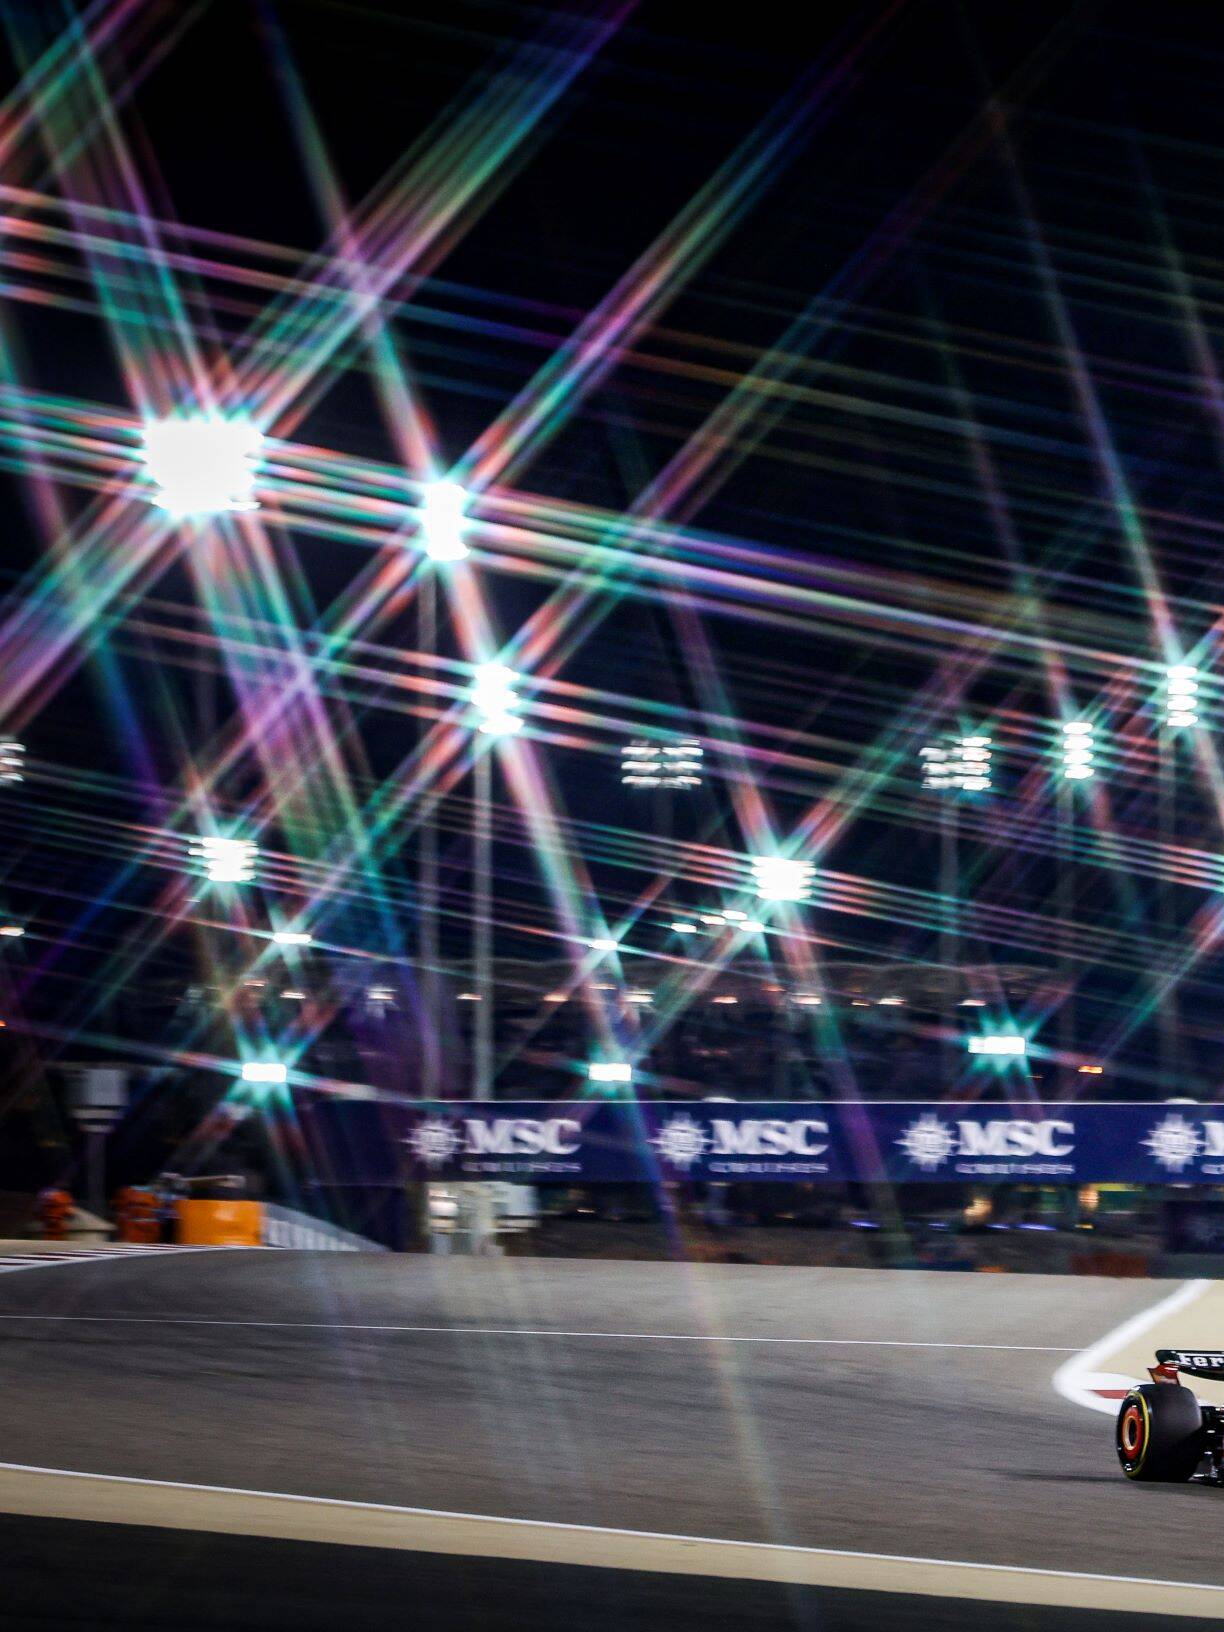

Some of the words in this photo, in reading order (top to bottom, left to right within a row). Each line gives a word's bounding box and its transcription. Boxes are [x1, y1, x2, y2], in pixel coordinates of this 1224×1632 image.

[462, 1119, 581, 1154] MSC
[708, 1119, 829, 1155] MSC
[954, 1119, 1075, 1156] MSC
